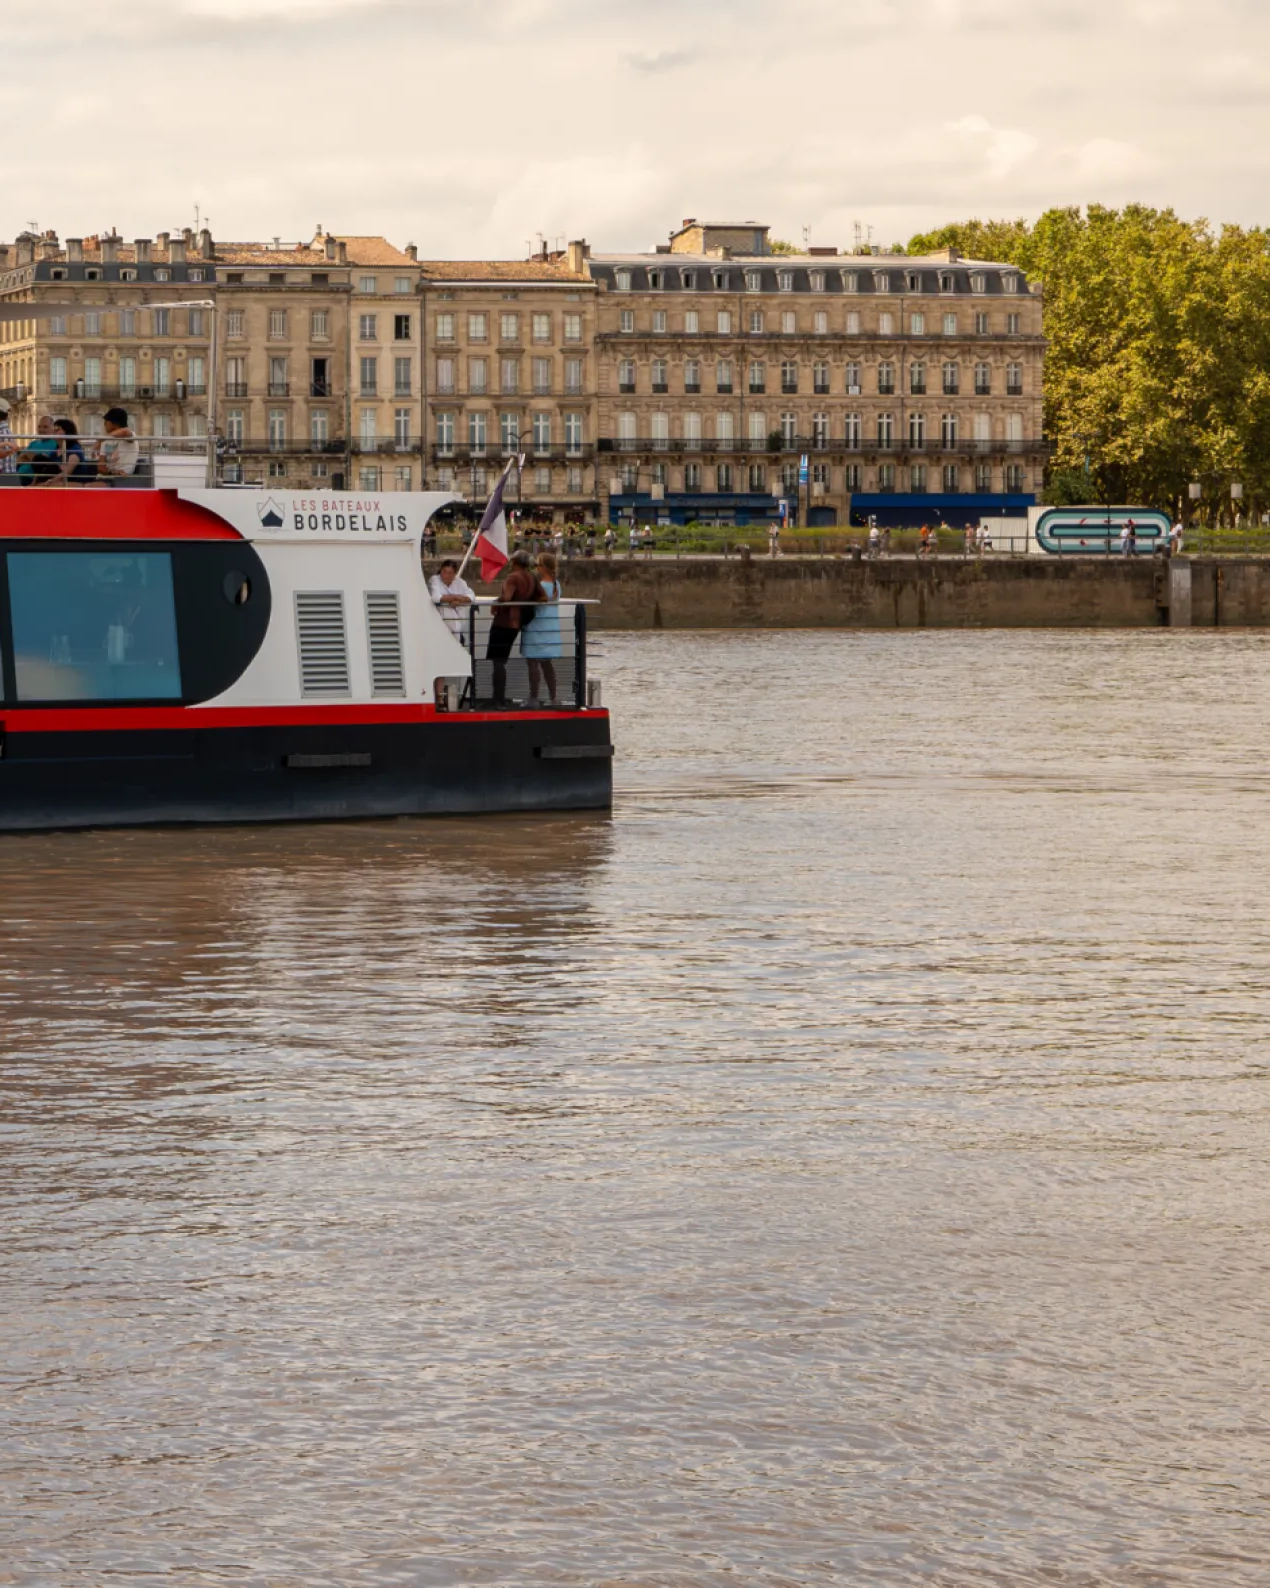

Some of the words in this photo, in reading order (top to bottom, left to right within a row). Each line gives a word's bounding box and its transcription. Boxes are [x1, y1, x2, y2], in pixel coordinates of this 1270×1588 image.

[293, 499, 317, 512] LES
[322, 500, 380, 512] BATEAUX
[294, 514, 408, 532] BORDELAIS
